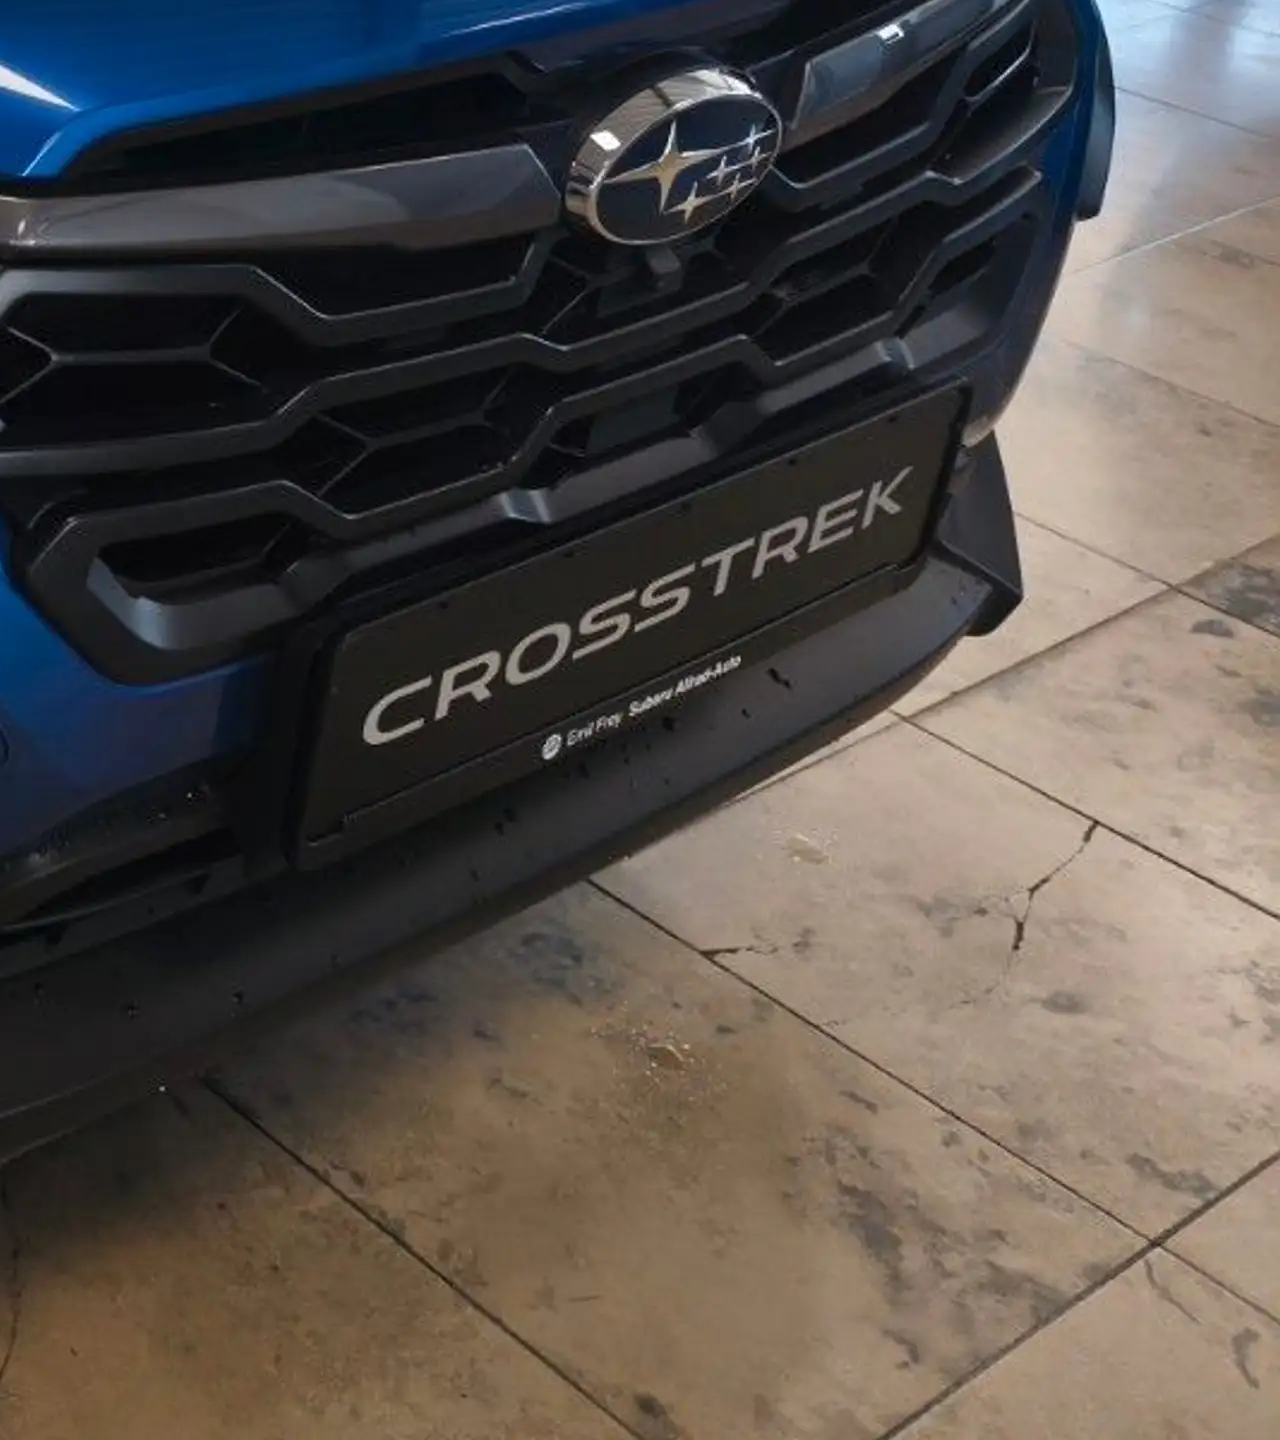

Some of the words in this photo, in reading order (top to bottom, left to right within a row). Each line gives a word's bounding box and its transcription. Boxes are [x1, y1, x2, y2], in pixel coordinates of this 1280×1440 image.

[361, 465, 914, 746] CROSSTREK
[566, 721, 596, 747] Emil
[595, 712, 624, 733] Frey
[628, 687, 675, 718] Subaru
